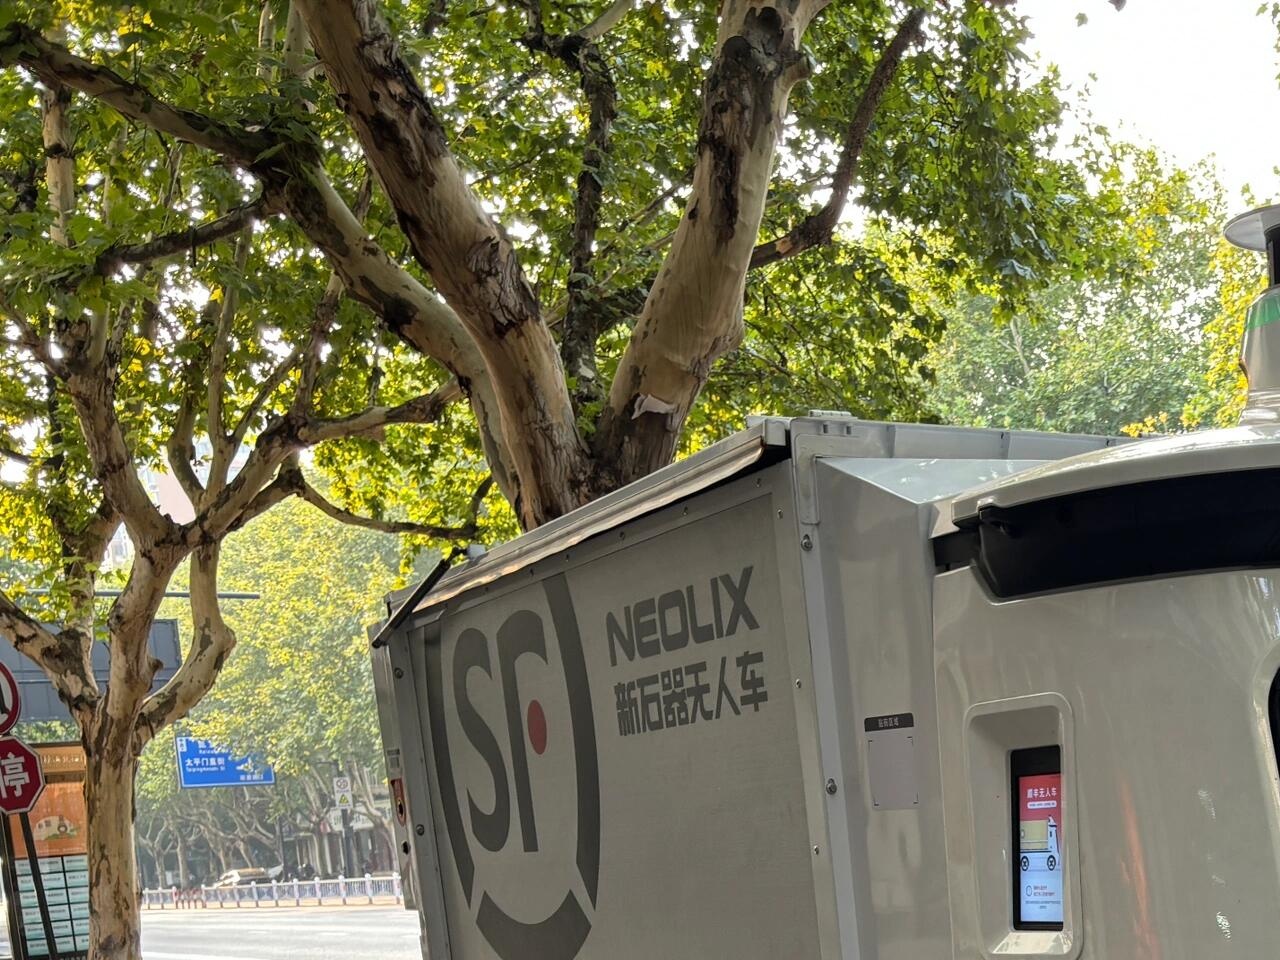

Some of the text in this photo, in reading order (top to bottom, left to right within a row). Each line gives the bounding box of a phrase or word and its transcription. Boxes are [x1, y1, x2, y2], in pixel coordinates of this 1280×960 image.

[606, 565, 760, 667] NEOLIX
[613, 650, 768, 737] 新石器无人车
[0, 751, 30, 799] 停
